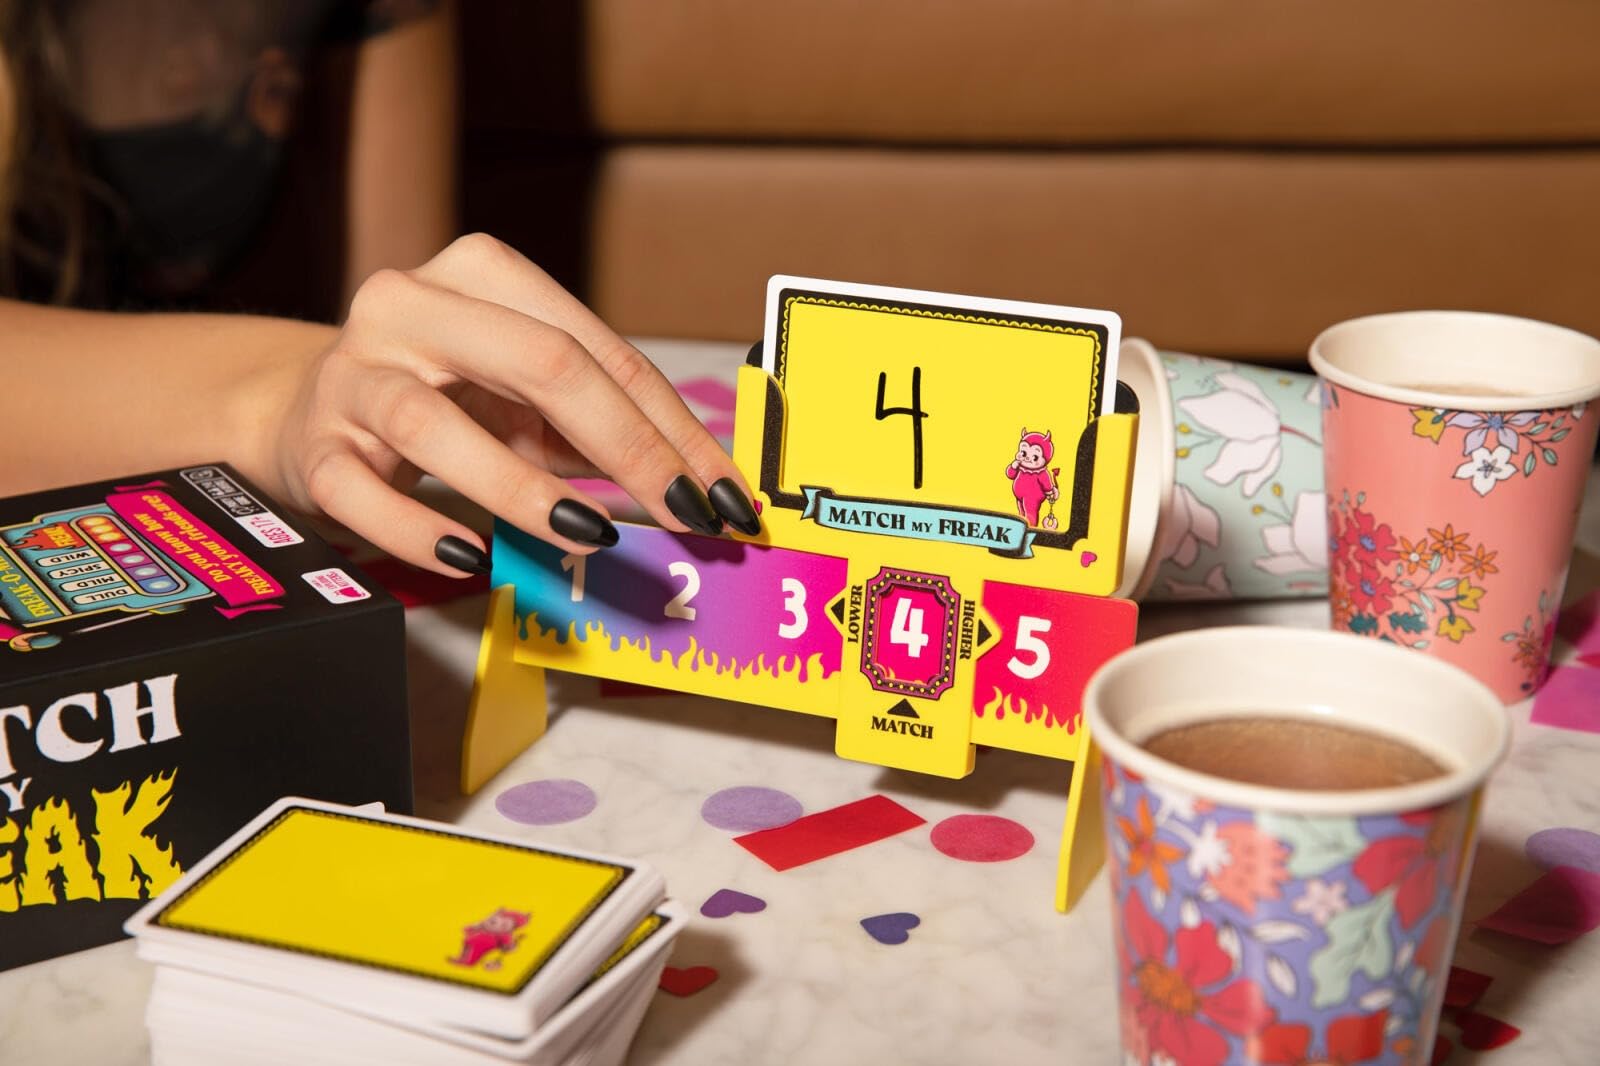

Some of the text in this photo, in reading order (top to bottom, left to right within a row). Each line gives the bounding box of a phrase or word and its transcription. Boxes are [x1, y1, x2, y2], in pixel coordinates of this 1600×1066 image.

[875, 366, 929, 489] 4
[162, 510, 208, 542] friends
[261, 527, 293, 544] AGES
[828, 506, 1013, 544] MATCH MY FREAK
[50, 551, 90, 563] WILD
[133, 513, 233, 583] Do you know how
[200, 540, 239, 561] your
[59, 563, 102, 576] SPICY
[76, 576, 115, 588] MILD
[226, 559, 275, 595] FREAKY
[86, 588, 128, 601] DULL
[560, 553, 1052, 680] 1 2 3 4 5
[847, 585, 863, 644] LOWER
[959, 599, 975, 660] HIGHER
[871, 716, 934, 739] MATCH
